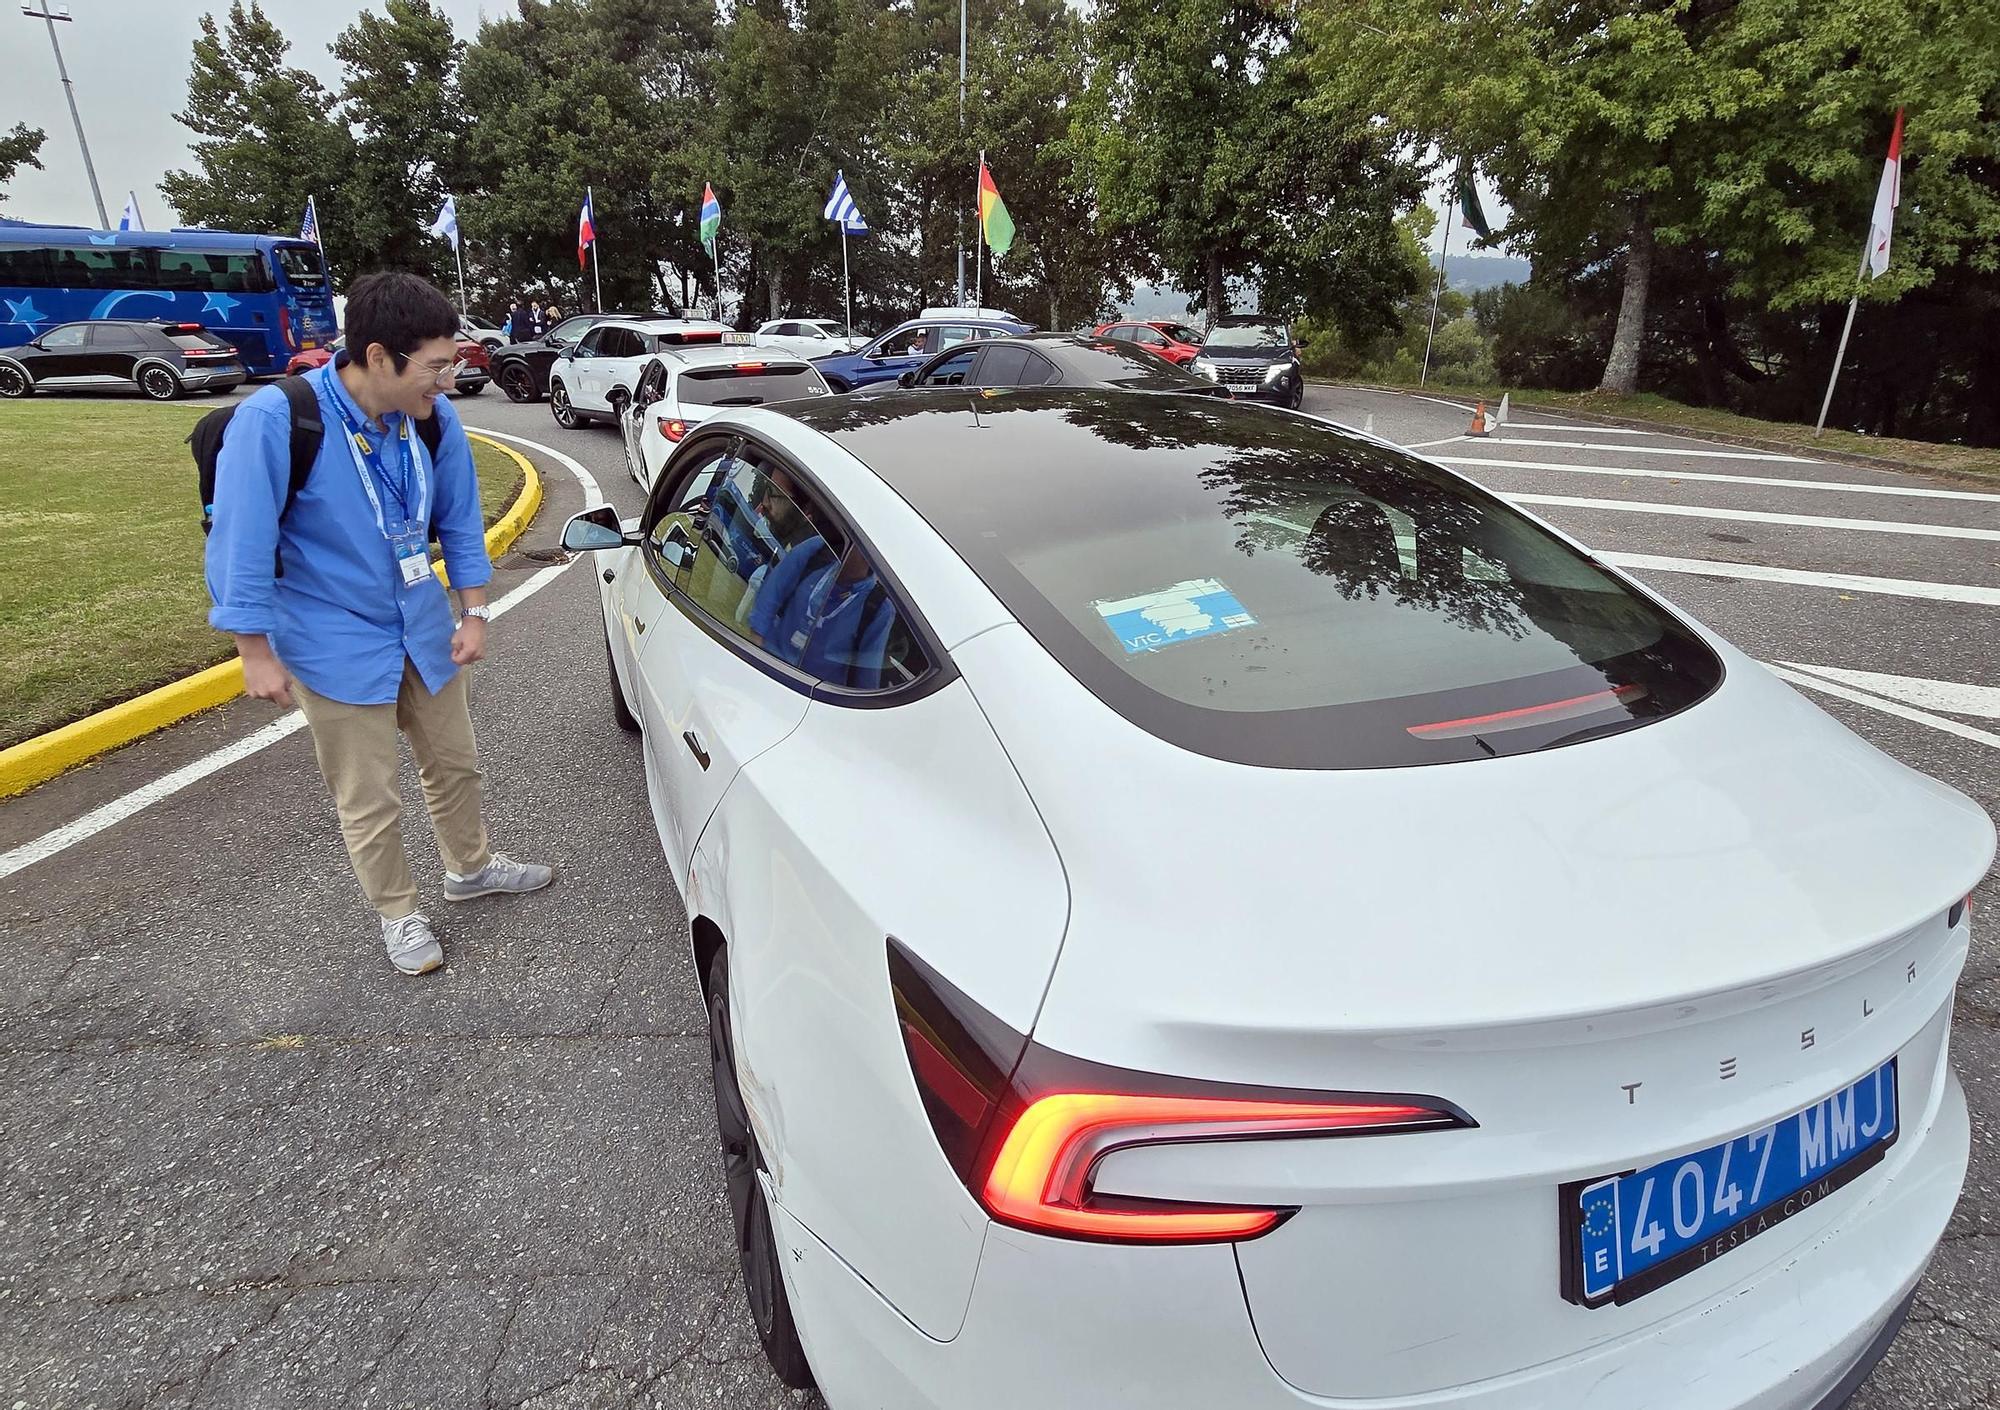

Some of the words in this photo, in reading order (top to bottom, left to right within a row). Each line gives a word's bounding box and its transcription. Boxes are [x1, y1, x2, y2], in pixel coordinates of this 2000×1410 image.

[734, 335, 750, 343] TAXI
[808, 386, 824, 394] 552
[1125, 633, 1162, 647] VTC
[1621, 961, 1916, 1105] TESLA
[1594, 1248, 1609, 1273] E
[1631, 1123, 1777, 1257] 4047
[1799, 1068, 1882, 1178] MMJ
[1701, 1179, 1830, 1263] TESLA.COM
